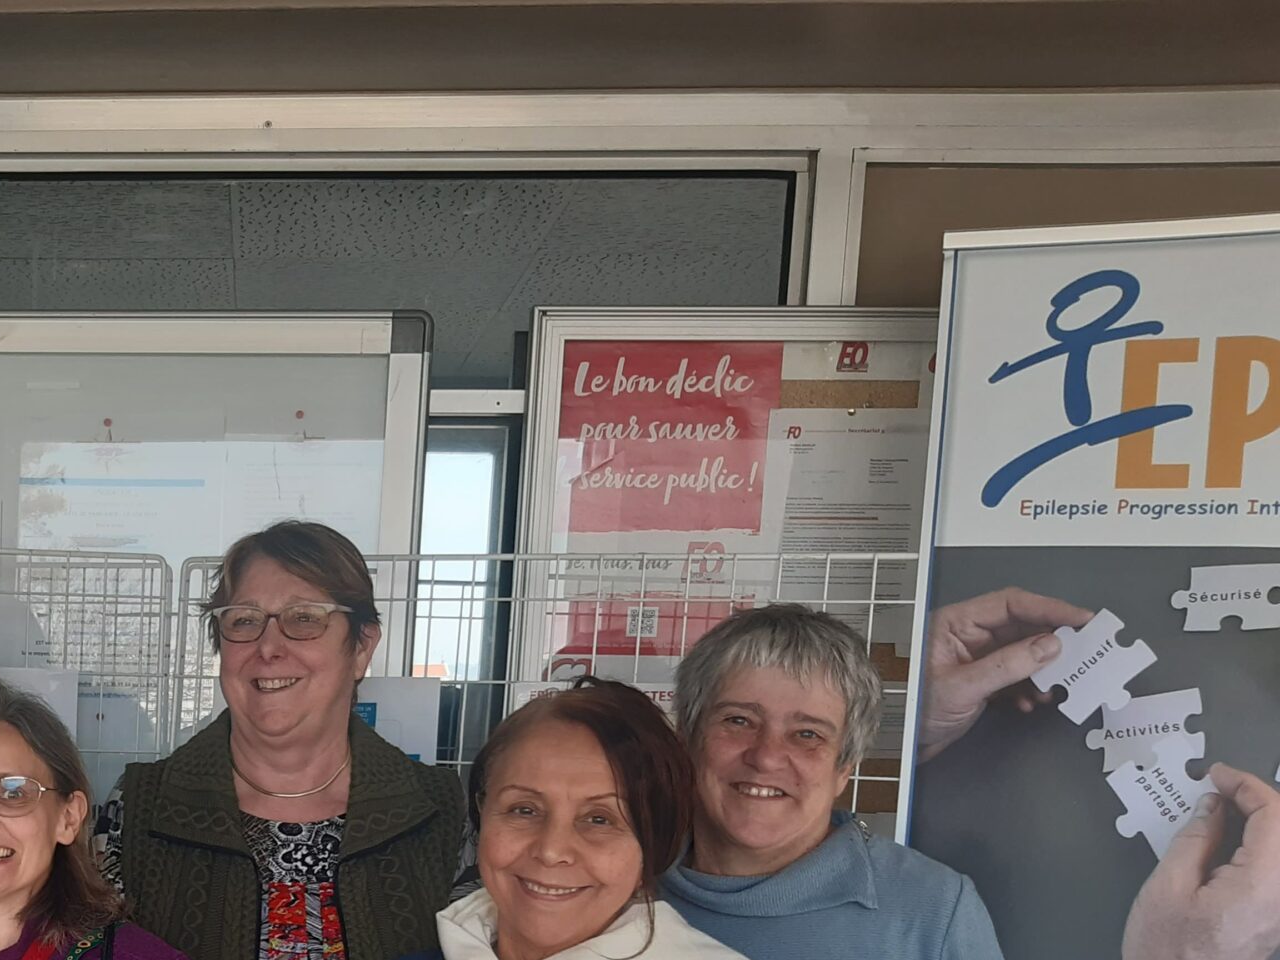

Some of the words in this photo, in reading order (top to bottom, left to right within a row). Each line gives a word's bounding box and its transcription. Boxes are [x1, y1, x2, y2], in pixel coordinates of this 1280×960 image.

[574, 361, 610, 397] Le
[612, 356, 663, 396] bon
[666, 355, 754, 399] déclic
[577, 415, 643, 459] pour
[647, 415, 740, 443] sauver
[787, 426, 802, 439] FO
[578, 466, 663, 490] service
[663, 456, 744, 505] public
[748, 462, 758, 492] !
[1020, 499, 1108, 520] Epilepsie
[1117, 499, 1239, 520] Progression
[1246, 499, 1280, 516] Int
[1188, 589, 1262, 603] Sécurisé
[1063, 639, 1114, 687] Inclusif
[1103, 722, 1181, 740] Activités
[1135, 776, 1178, 822] partagé
[1151, 767, 1192, 814] Habitat
